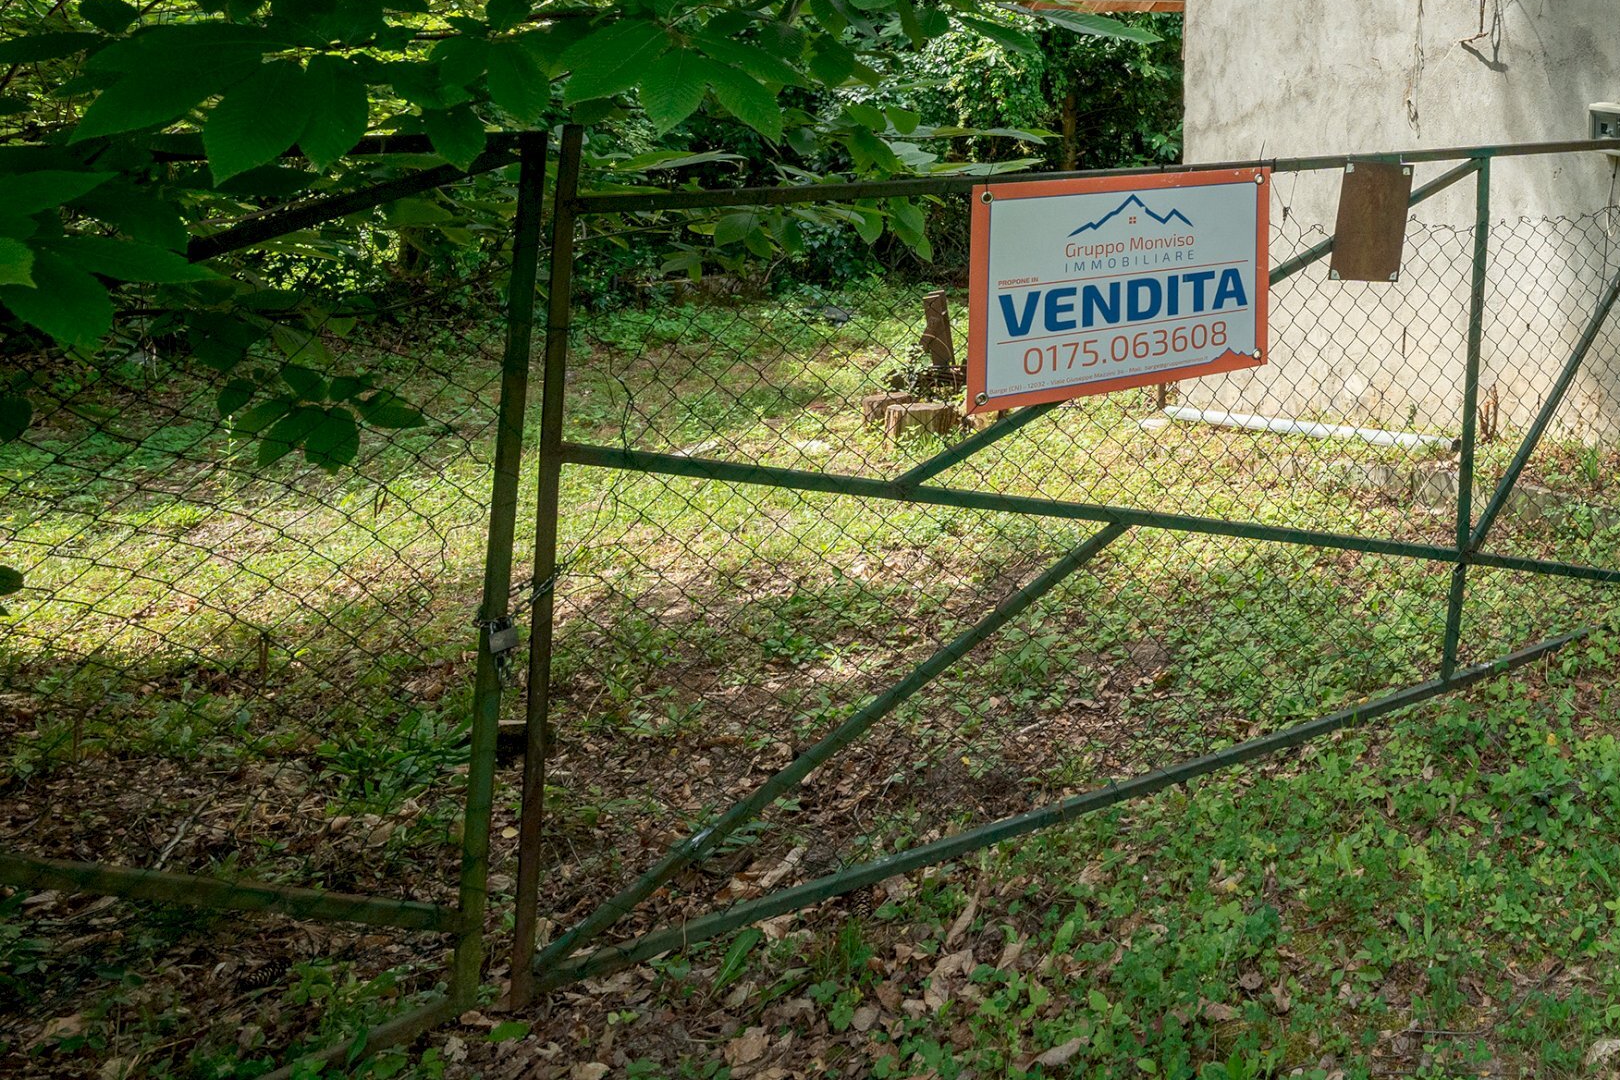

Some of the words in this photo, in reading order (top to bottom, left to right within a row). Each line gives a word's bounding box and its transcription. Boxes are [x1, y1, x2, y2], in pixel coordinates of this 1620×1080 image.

[1065, 242, 1125, 258] Gruppo
[1130, 233, 1195, 251] Monviso
[1064, 250, 1195, 273] IMMOBILIARE
[998, 277, 1030, 286] PROPONE
[998, 267, 1248, 338] VENDITA
[1023, 320, 1228, 376] 0175.063608
[1027, 380, 1046, 389] 12032
